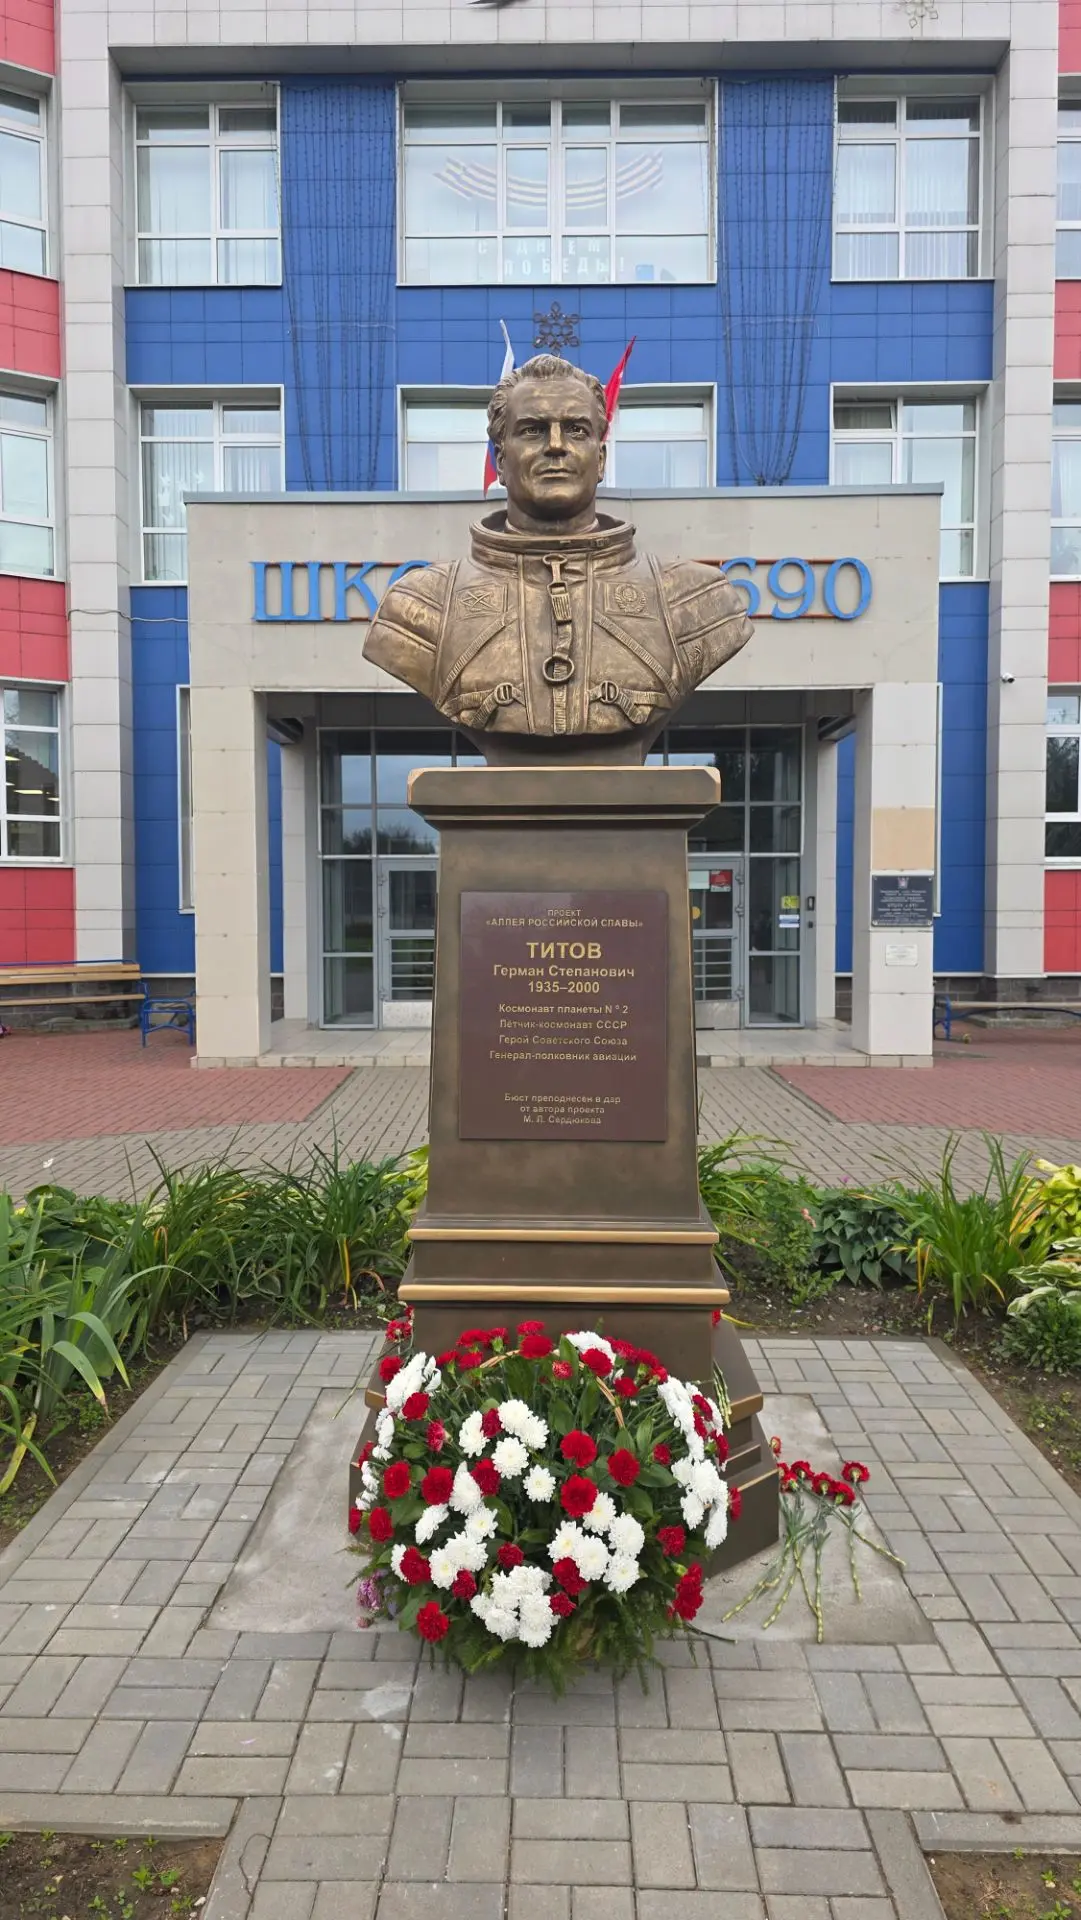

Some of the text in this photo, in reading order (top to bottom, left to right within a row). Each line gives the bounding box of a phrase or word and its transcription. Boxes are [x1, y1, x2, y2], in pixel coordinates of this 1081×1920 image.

[547, 909, 582, 917] ПРОЕКТ
[528, 917, 598, 928] РОССИЙСКОЙ
[526, 942, 602, 959] ТИТОВ
[493, 964, 635, 979] Герман Степанович
[499, 1003, 555, 1014] Космонавт
[557, 1005, 602, 1014] планеты
[622, 1004, 629, 1014] 2
[596, 1020, 628, 1030] СССР
[499, 1034, 628, 1046] Герой Советского Союза
[489, 1050, 637, 1063] Генерал-полковник авиации
[504, 1093, 529, 1102] Бюст
[603, 1096, 621, 1105] дар
[533, 1106, 565, 1114] автора
[567, 1107, 605, 1115] проекта
